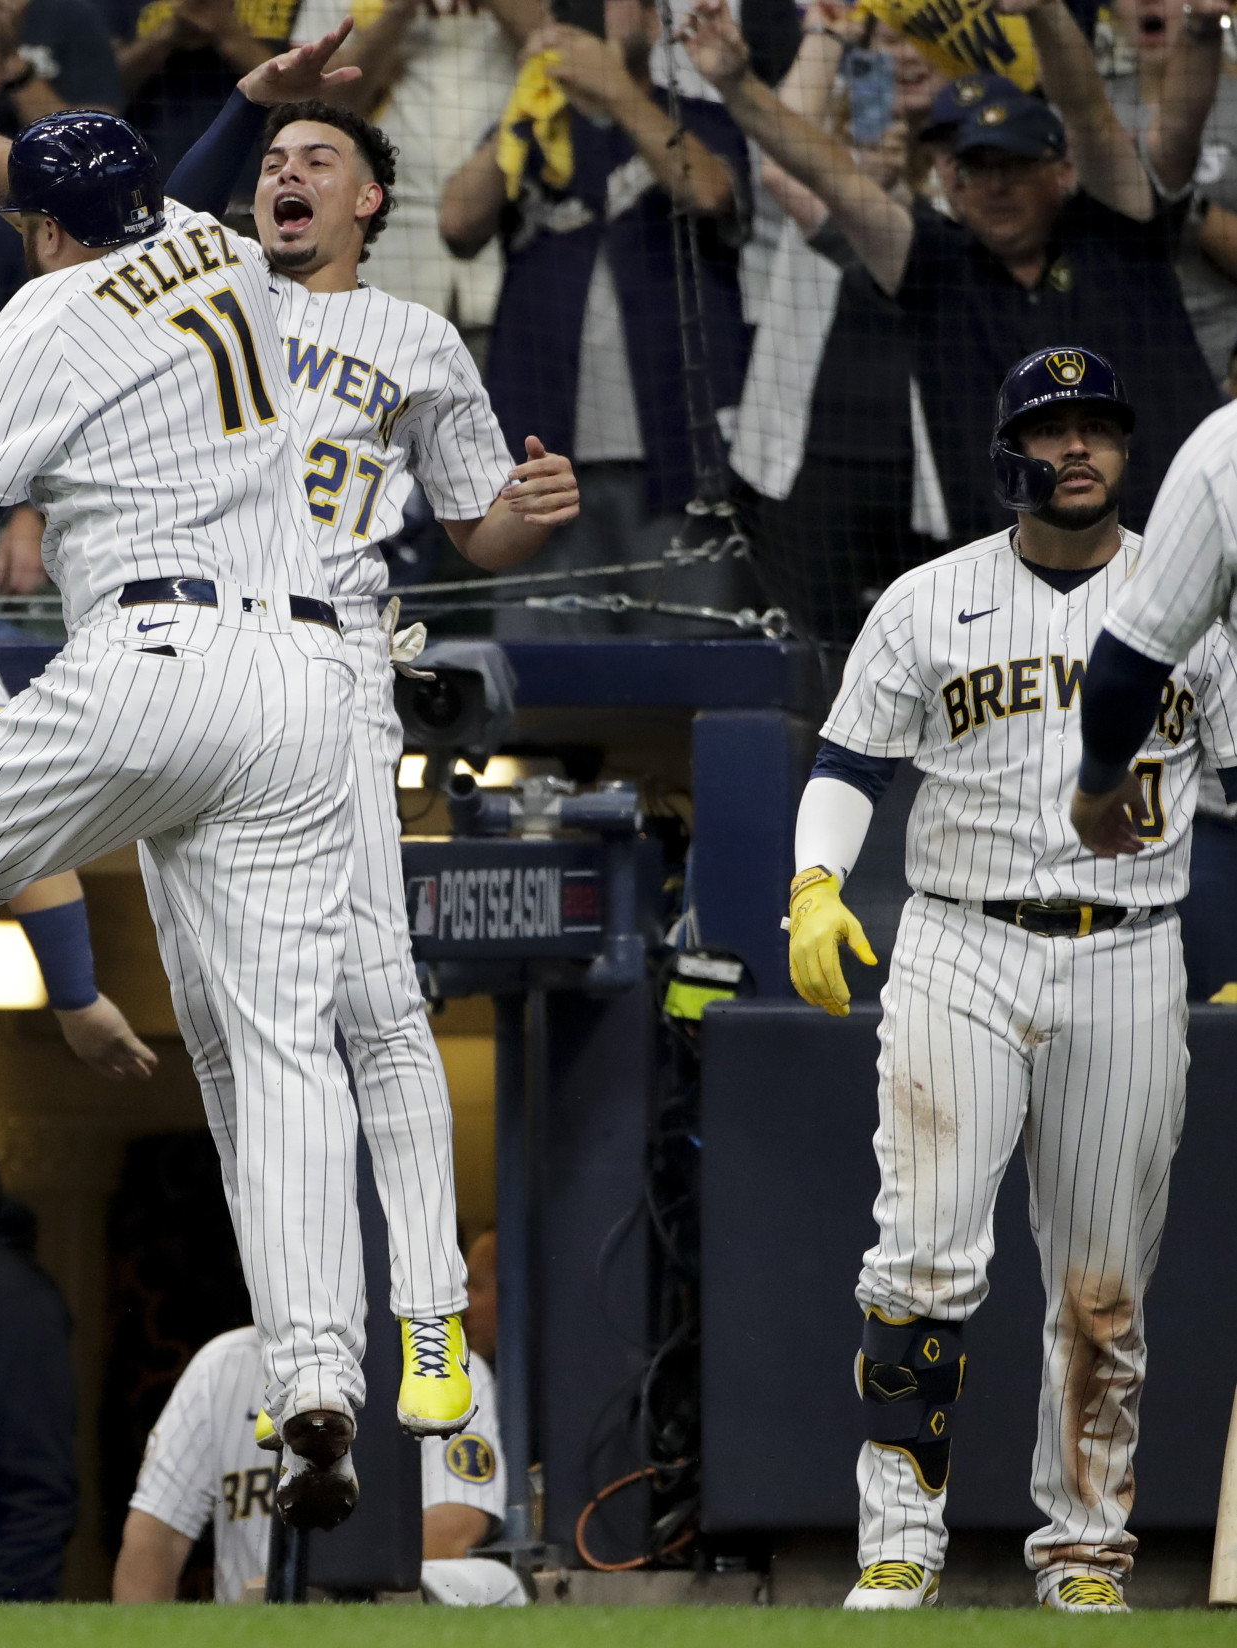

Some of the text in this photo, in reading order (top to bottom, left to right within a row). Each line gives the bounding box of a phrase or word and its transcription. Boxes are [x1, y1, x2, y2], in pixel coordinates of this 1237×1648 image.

[93, 224, 242, 318] TELLEZ
[167, 287, 278, 436] 11
[284, 336, 409, 450] WER
[304, 437, 385, 540] 27
[438, 867, 563, 941] POSTSEASON
